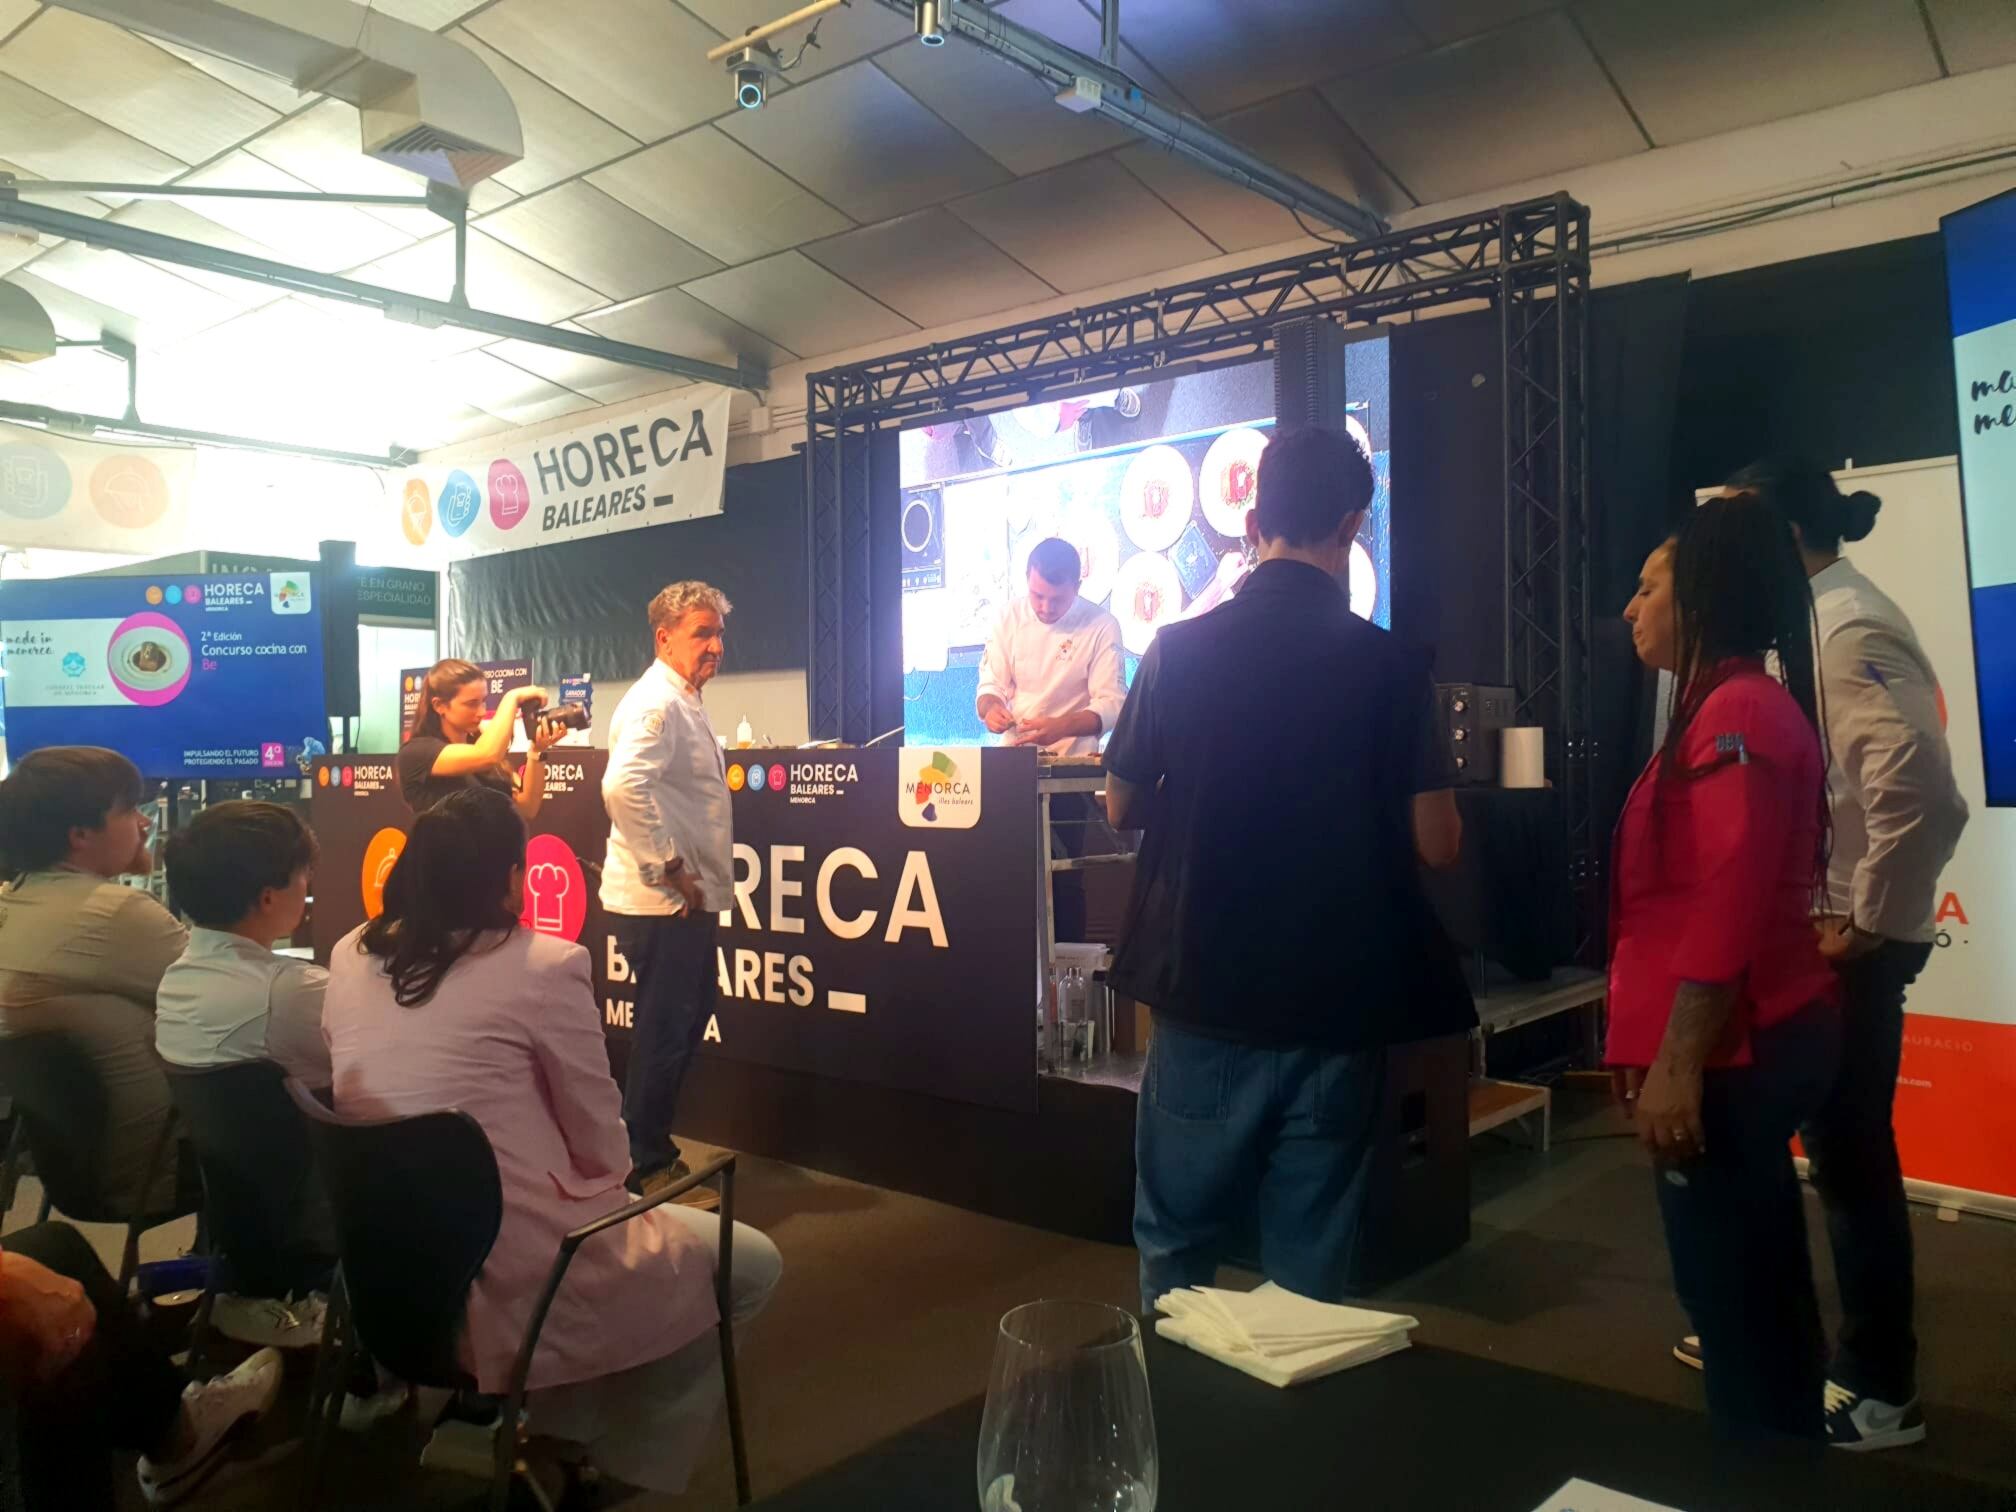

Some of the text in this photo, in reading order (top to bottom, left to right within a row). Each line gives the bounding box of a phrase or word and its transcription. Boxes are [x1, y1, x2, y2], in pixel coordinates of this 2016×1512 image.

[1971, 370, 2016, 402] ma
[533, 408, 713, 495] HORECA
[542, 483, 646, 531] BALEARES
[204, 583, 264, 597] HORECA
[386, 579, 425, 592] GRANO
[205, 597, 244, 606] BALEARES
[213, 632, 242, 641] Edición
[201, 643, 307, 656] Concurso cocina con
[515, 668, 527, 676] CON
[491, 679, 504, 694] BE
[184, 750, 224, 758] IMPULSANDO
[232, 750, 259, 758] FUTURO
[354, 766, 393, 780] HORECA
[544, 764, 584, 781] ORECA
[790, 763, 858, 782] HORECA
[790, 784, 835, 795] BALEARES
[905, 782, 971, 795] MENORCA
[719, 842, 949, 948] RECA
[606, 935, 815, 1007] BARES
